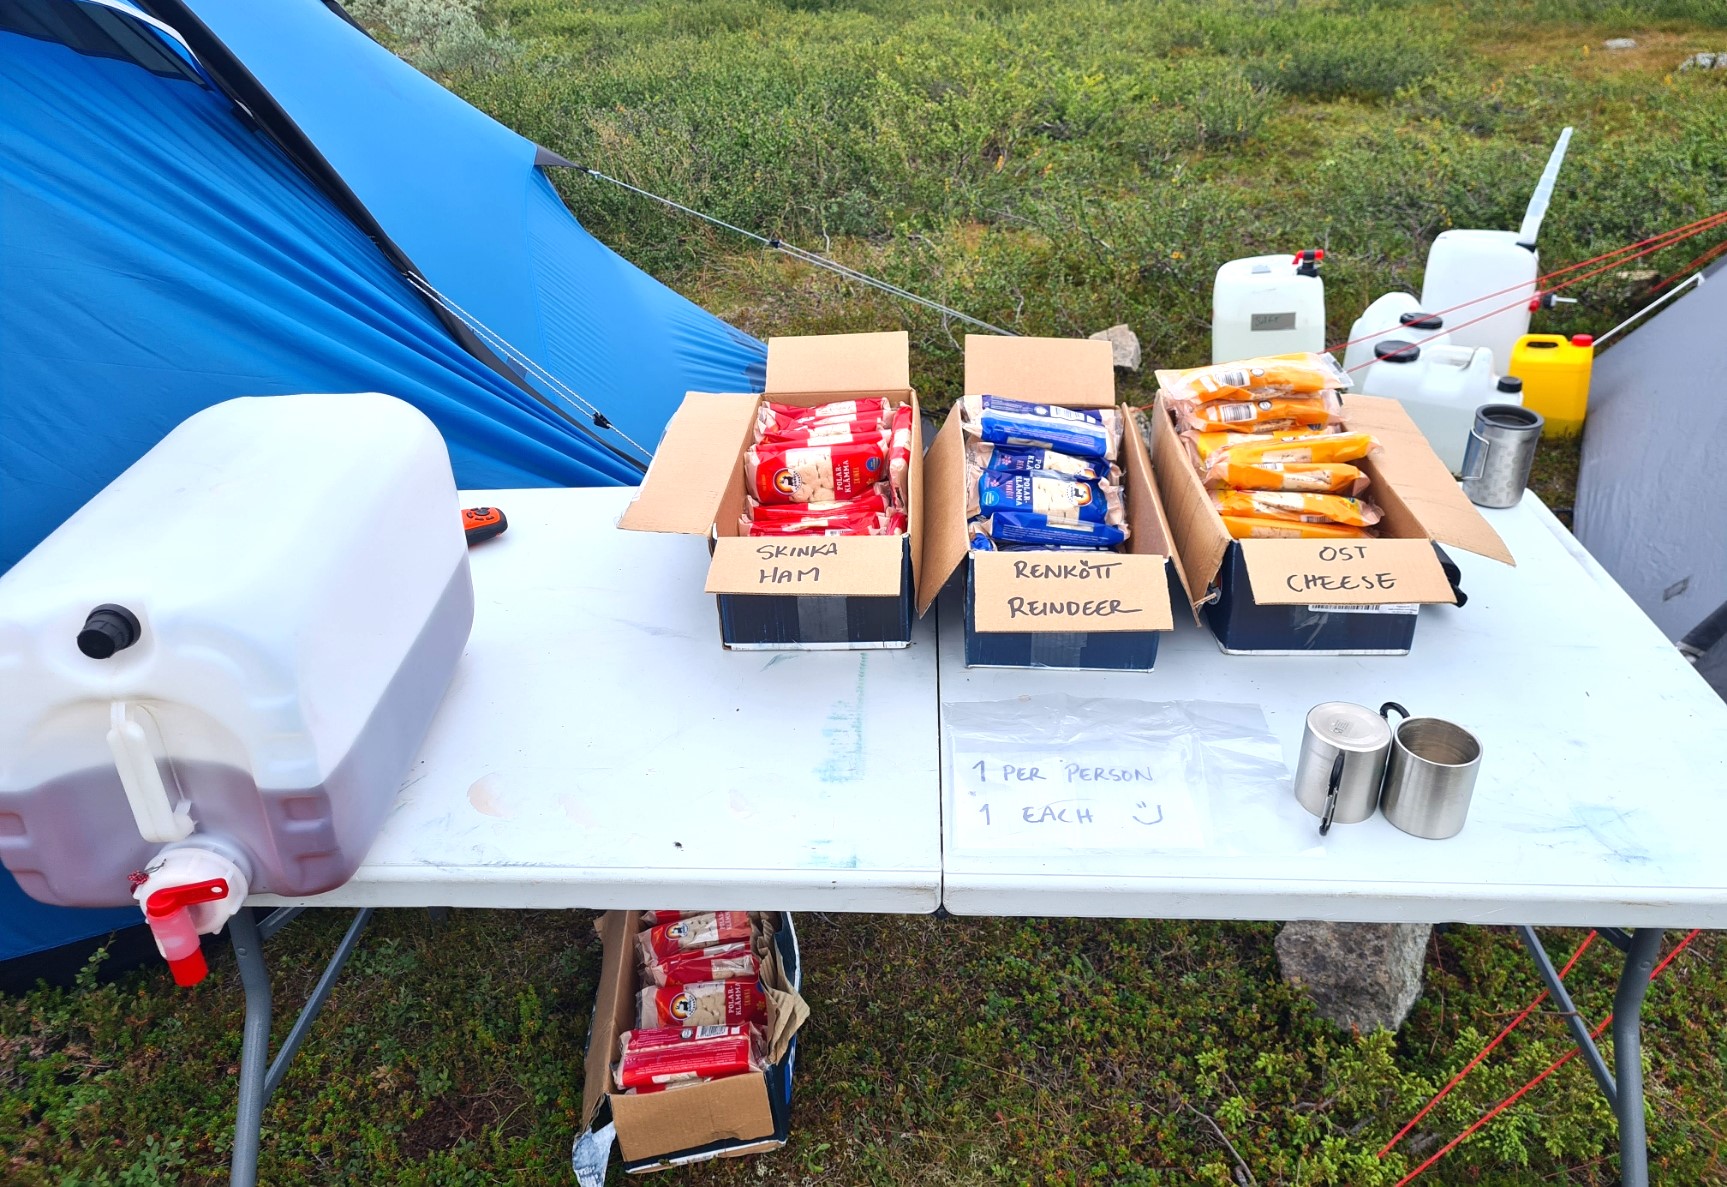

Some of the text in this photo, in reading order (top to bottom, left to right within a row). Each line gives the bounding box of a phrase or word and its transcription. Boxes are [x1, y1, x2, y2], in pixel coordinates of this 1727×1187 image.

[1023, 477, 1031, 504] POLAR-
[756, 542, 838, 560] SKINKA
[1318, 546, 1368, 561] OST
[759, 566, 820, 584] HAM
[1013, 559, 1123, 580] RENKÖTT
[1286, 572, 1397, 593] CHEESE
[1007, 596, 1143, 619] REINDEER
[972, 760, 1154, 783] 1 PER PERSON
[979, 803, 1094, 826] 1 EACH
